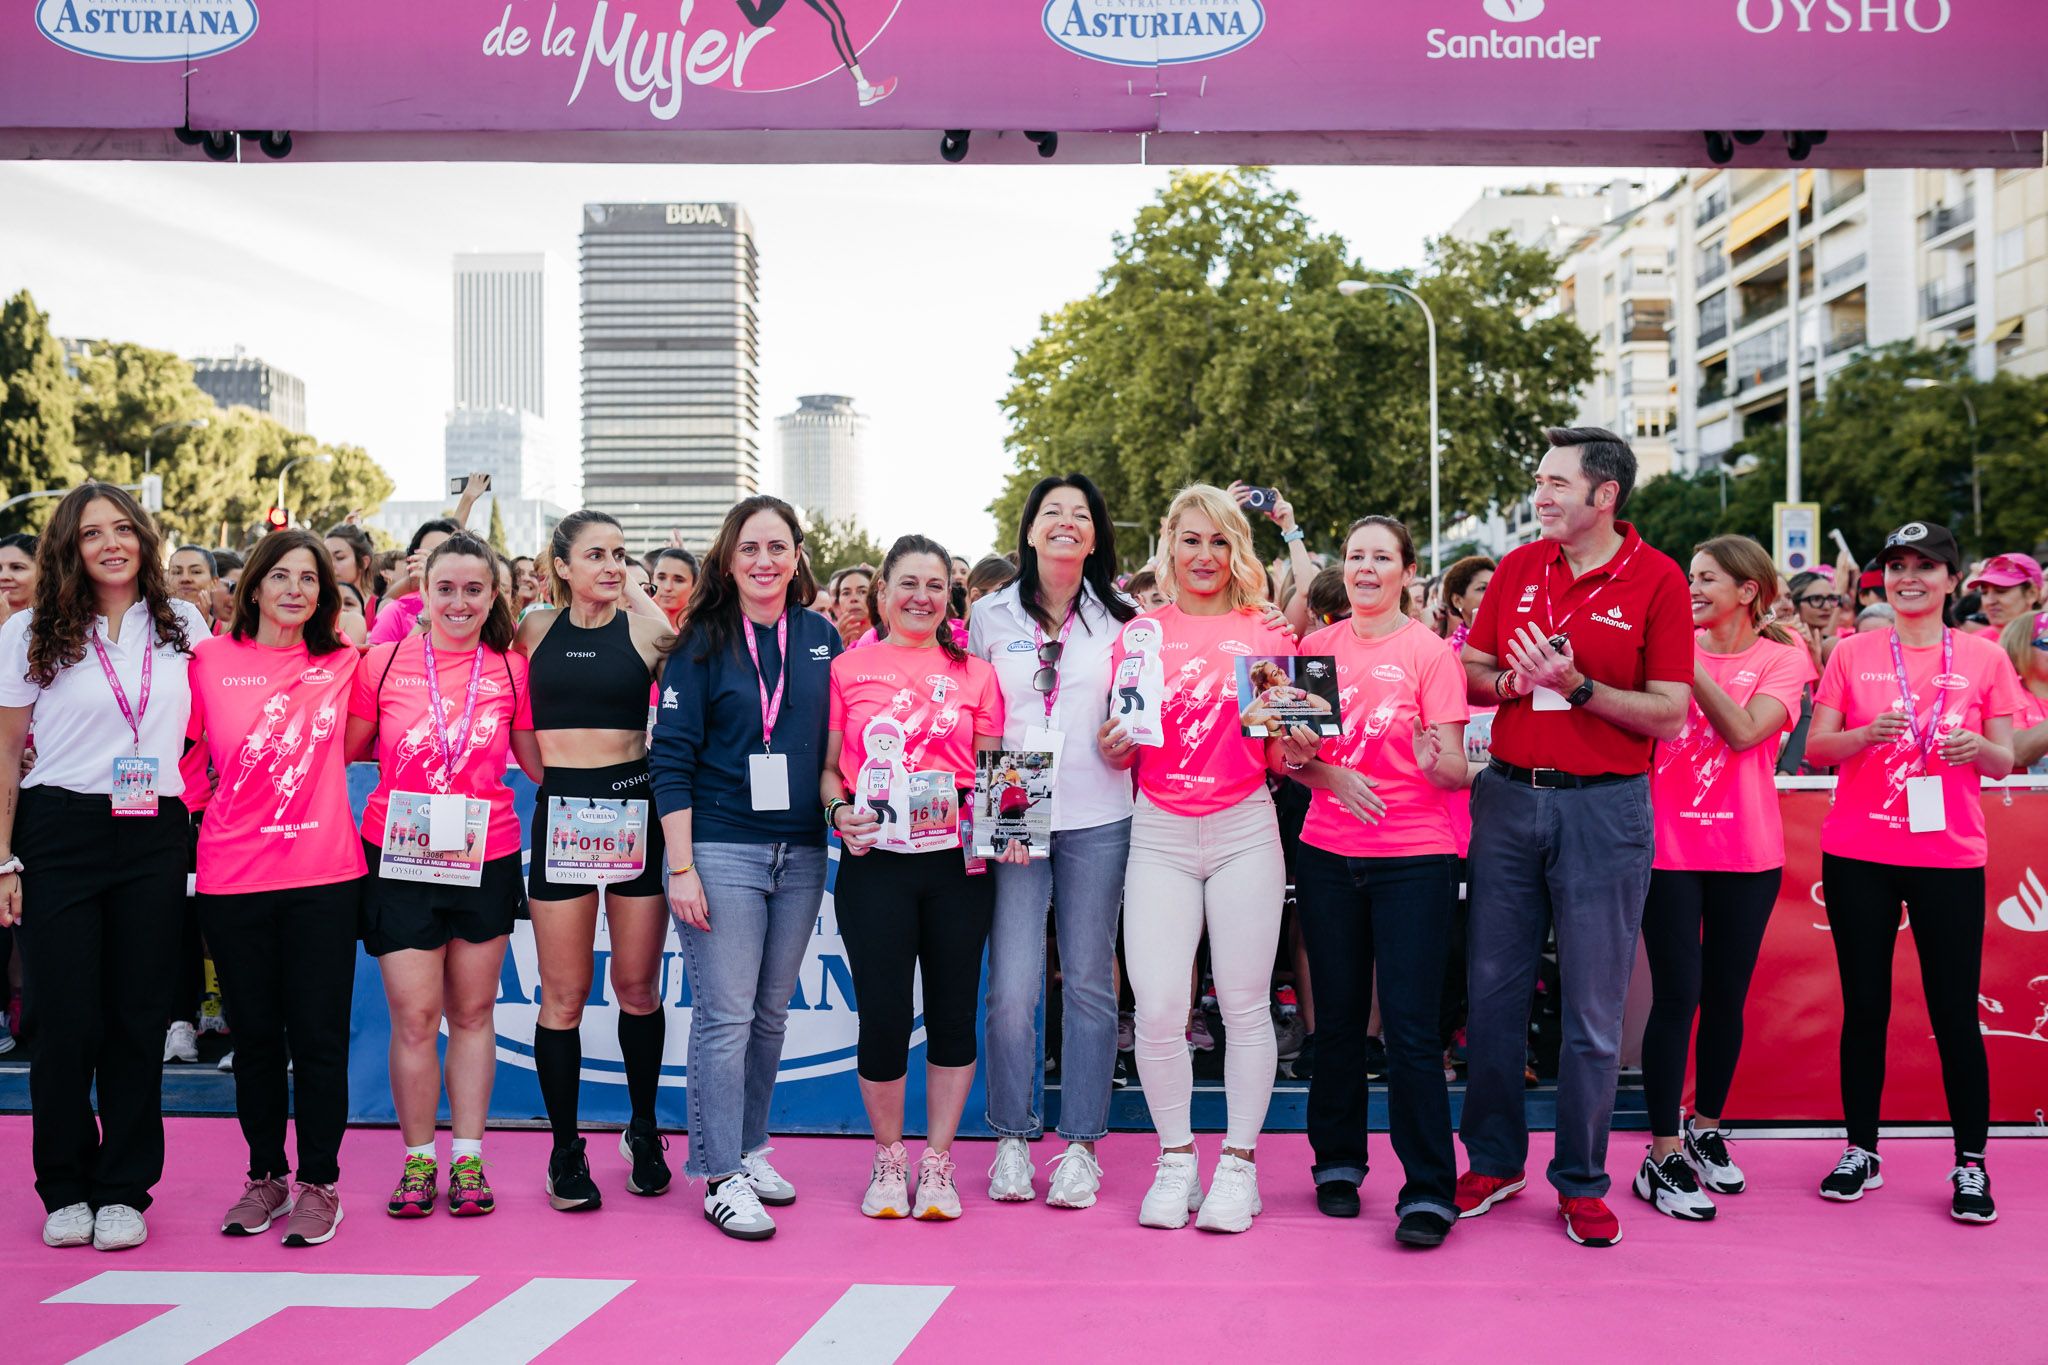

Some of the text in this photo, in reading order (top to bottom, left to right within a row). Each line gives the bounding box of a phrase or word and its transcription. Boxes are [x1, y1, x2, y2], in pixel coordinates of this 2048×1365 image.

[53, 0, 240, 34] ASTURIANA
[1060, 0, 1247, 38] ASTURIANA
[1736, 0, 1951, 33] OYSHO
[1427, 28, 1601, 59] Santander
[482, 0, 776, 120] de la Mujer
[666, 204, 722, 224] BBVA
[1590, 612, 1632, 631] Santander
[1160, 641, 1188, 650] YSHO
[222, 676, 267, 687] OYSHO
[117, 763, 150, 771] MUJER
[612, 773, 650, 790] OYSHO
[580, 811, 616, 820] ASTURIANA
[910, 806, 929, 822] 16
[1869, 812, 1890, 821] CARRERA
[260, 825, 284, 833] CARRERA
[293, 823, 300, 831] LA
[301, 821, 319, 829] MUJER
[579, 837, 615, 851] 016
[921, 839, 948, 847] Santander
[422, 851, 444, 859] 13086
[391, 866, 471, 880] OYSHO Santander
[556, 871, 587, 879] OYSHO
